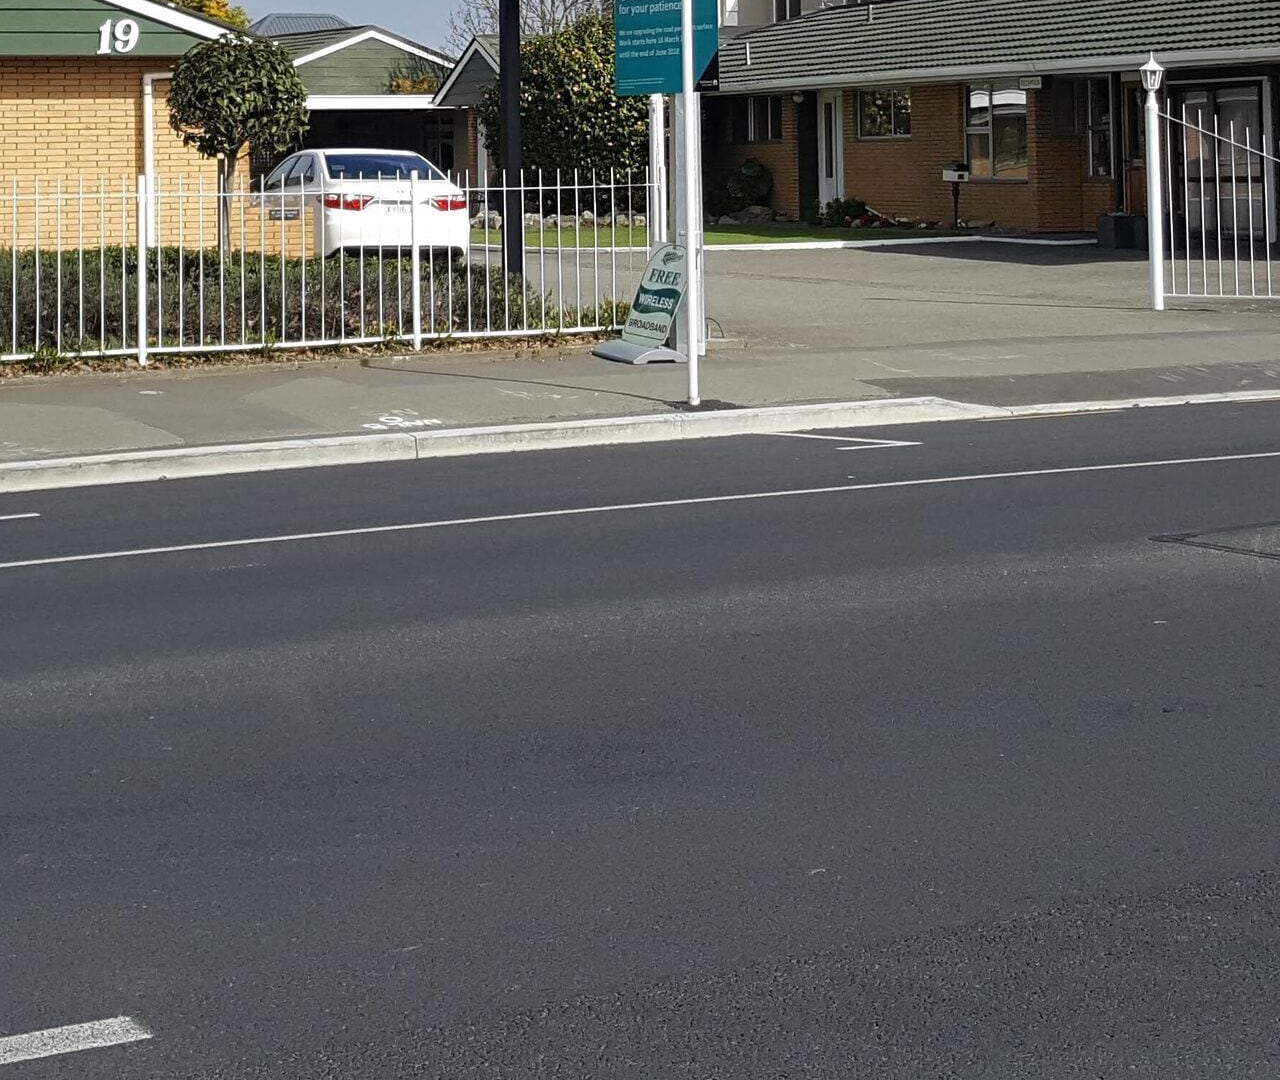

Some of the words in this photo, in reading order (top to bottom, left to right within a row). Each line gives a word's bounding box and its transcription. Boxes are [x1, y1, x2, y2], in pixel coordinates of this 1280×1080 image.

[619, 4, 629, 15] for
[631, 4, 647, 17] your
[96, 18, 140, 55] 19
[648, 268, 681, 286] FREE
[638, 294, 674, 309] WIRELESS
[628, 318, 667, 334] BROADBAND
